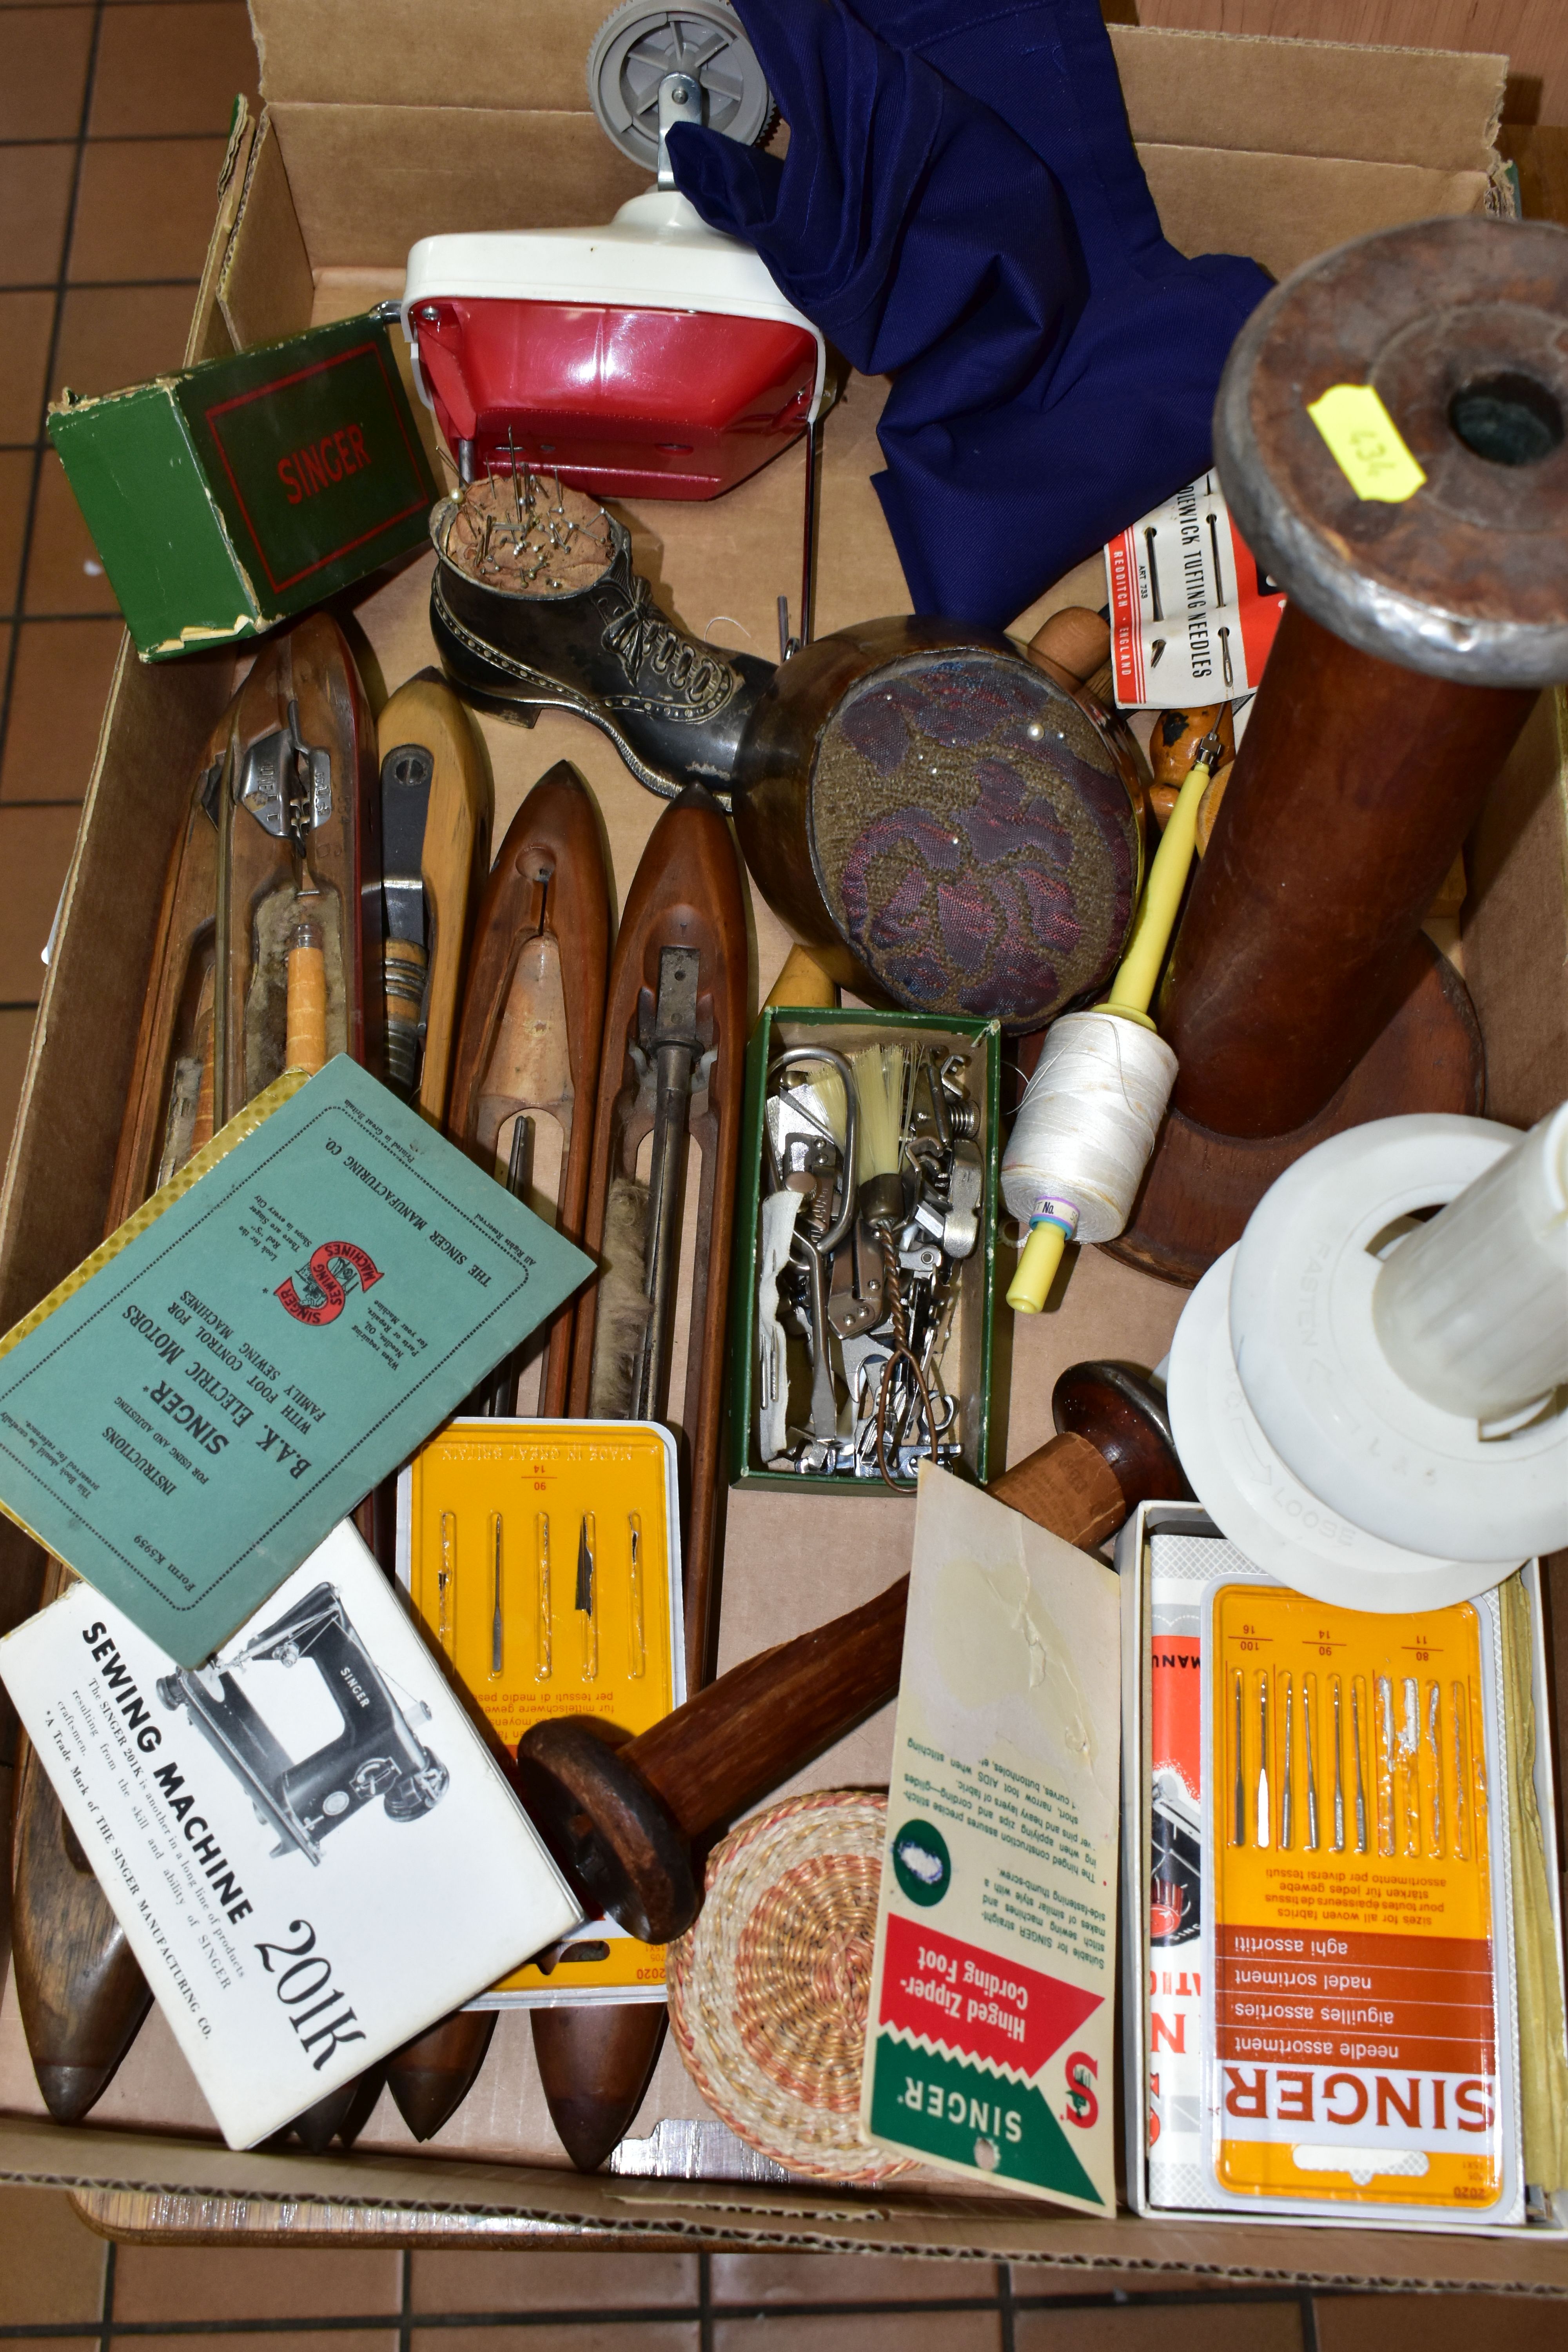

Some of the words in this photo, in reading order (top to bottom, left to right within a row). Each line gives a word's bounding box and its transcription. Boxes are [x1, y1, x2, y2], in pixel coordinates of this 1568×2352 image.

[278, 425, 371, 505] SINGER
[1113, 551, 1127, 607] REDDITCH
[1183, 550, 1206, 609] TUFTING
[1116, 624, 1131, 675] ENGLAND
[1188, 612, 1211, 678] NEEDLES
[344, 1099, 365, 1120] Britain
[365, 1118, 383, 1135] Great
[325, 1137, 342, 1155] CO.
[384, 1134, 392, 1142] in
[390, 1141, 415, 1163] Printed
[254, 1195, 267, 1208] City
[343, 1156, 427, 1230] MANUFACTURING
[249, 1205, 269, 1224] Singer
[267, 1207, 285, 1222] every
[1042, 1201, 1055, 1215] No.
[238, 1225, 249, 1236] the
[270, 1223, 281, 1233] are
[286, 1222, 294, 1231] in
[474, 1213, 504, 1240] Reserved
[250, 1236, 261, 1246] for
[282, 1234, 300, 1252] There
[294, 1229, 312, 1247] Shops
[429, 1230, 467, 1265] SINGER
[504, 1238, 524, 1258] Rights
[261, 1245, 277, 1261] Look
[325, 1244, 375, 1281] MACHINES
[523, 1255, 536, 1265] All
[313, 1264, 341, 1305] SEWING
[467, 1264, 491, 1287] THE
[1294, 1238, 1334, 1348] FASTEN
[167, 1301, 192, 1325] FOR
[180, 1290, 234, 1339] MACHINES
[280, 1288, 322, 1323] SINGER
[374, 1299, 400, 1324] Machine
[364, 1321, 376, 1334] Oil,
[367, 1307, 392, 1333] Repairs,
[400, 1323, 416, 1337] your
[195, 1325, 243, 1370] CONTROL
[351, 1325, 380, 1350] requiring
[378, 1332, 403, 1358] Needles,
[401, 1339, 419, 1356] Parts
[416, 1338, 428, 1348] for
[238, 1342, 280, 1380] SEWING
[381, 1351, 399, 1370] When
[246, 1375, 278, 1403] FOOT
[283, 1384, 326, 1422] FAMILY
[111, 1393, 157, 1436] ADJUSTING
[280, 1404, 311, 1434] WITH
[149, 1429, 173, 1452] AND
[98, 1423, 176, 1499] INSTRUCTIONS
[165, 1444, 196, 1472] USING
[256, 1424, 312, 1479] B.A.K.
[442, 1447, 502, 1460] BRITAIN
[508, 1447, 560, 1460] GREAT
[566, 1447, 582, 1460] IN
[589, 1447, 632, 1460] MADE
[187, 1465, 211, 1487] FOR
[534, 1465, 545, 1473] 14
[534, 1481, 546, 1490] 90
[1271, 1485, 1356, 1548] LOOSE
[134, 1535, 166, 1564] K5959
[167, 1563, 196, 1592] Form
[1242, 1624, 1256, 1637] 16
[1317, 1628, 1331, 1640] 14
[1414, 1634, 1428, 1646] 11
[1238, 1639, 1259, 1652] 100
[1318, 1644, 1332, 1656] 90
[1414, 1650, 1430, 1663] 80
[88, 1678, 100, 1699] The
[340, 1667, 370, 1709] SINGER
[502, 1694, 535, 1702] medio
[540, 1693, 550, 1702] di
[555, 1693, 590, 1702] tessuti
[596, 1692, 613, 1701] per
[58, 1701, 86, 1756] craftsmen.
[99, 1701, 127, 1747] SINGER
[123, 1748, 143, 1778] 201K
[82, 1622, 161, 1753] SEWING
[153, 1762, 253, 1925] MACHINE
[139, 1779, 147, 1789] is
[145, 1793, 170, 1834] another
[72, 1690, 98, 1736] resulting
[100, 1743, 116, 1770] from
[118, 1779, 129, 1796] the
[133, 1806, 149, 1829] skill
[148, 1839, 164, 1860] and
[163, 1869, 183, 1905] ability
[187, 1915, 200, 1927] of
[198, 1935, 231, 1989] SINGER
[168, 1836, 177, 1849] in
[181, 1860, 196, 1887] long
[997, 1867, 1050, 1898] thumb-screw.
[53, 1730, 71, 1761] Trade
[70, 1766, 89, 1796] Mark
[87, 1802, 99, 1812] of
[96, 1815, 114, 1844] THE
[112, 1847, 139, 1895] SINGER
[140, 1900, 197, 2012] MANUFACTURING
[198, 2017, 211, 2039] CO.
[995, 1884, 1011, 1894] with
[195, 1887, 209, 1908] line
[982, 1894, 998, 1907] and
[1015, 1891, 1034, 1906] style
[1053, 1890, 1106, 1920] side-fastening
[208, 1914, 220, 1924] of
[1005, 1903, 1044, 1927] machines
[1039, 1903, 1064, 1918] similar
[1069, 1915, 1077, 1924] of
[982, 1912, 1014, 1930] straight-
[1050, 1922, 1077, 1940] sewing
[1081, 1921, 1106, 1937] makes
[1019, 1926, 1053, 1948] SINGER
[1083, 1937, 1105, 1952] stitch
[1235, 1937, 1303, 1952] assortiti
[1311, 1938, 1347, 1956] aghi
[213, 1928, 243, 1977] products
[1057, 1940, 1069, 1955] for
[915, 1942, 962, 1987] Foot
[1073, 1947, 1105, 1969] Suitable
[635, 1966, 665, 1980] 2020
[1236, 1970, 1316, 1986] sortiment
[1324, 1975, 1370, 1990] nadel
[255, 1919, 366, 2071] 201K
[959, 1958, 1030, 2012] Cording
[897, 1969, 965, 2022] Zipper-
[963, 1992, 1027, 2045] Hinged
[1235, 2003, 1313, 2019] assorties
[1321, 2007, 1393, 2025] aiguilles
[1233, 2037, 1332, 2054] assortment
[1340, 2042, 1400, 2062] needle
[1226, 2067, 1496, 2133] SINGER
[1454, 2187, 1485, 2199] 2020
